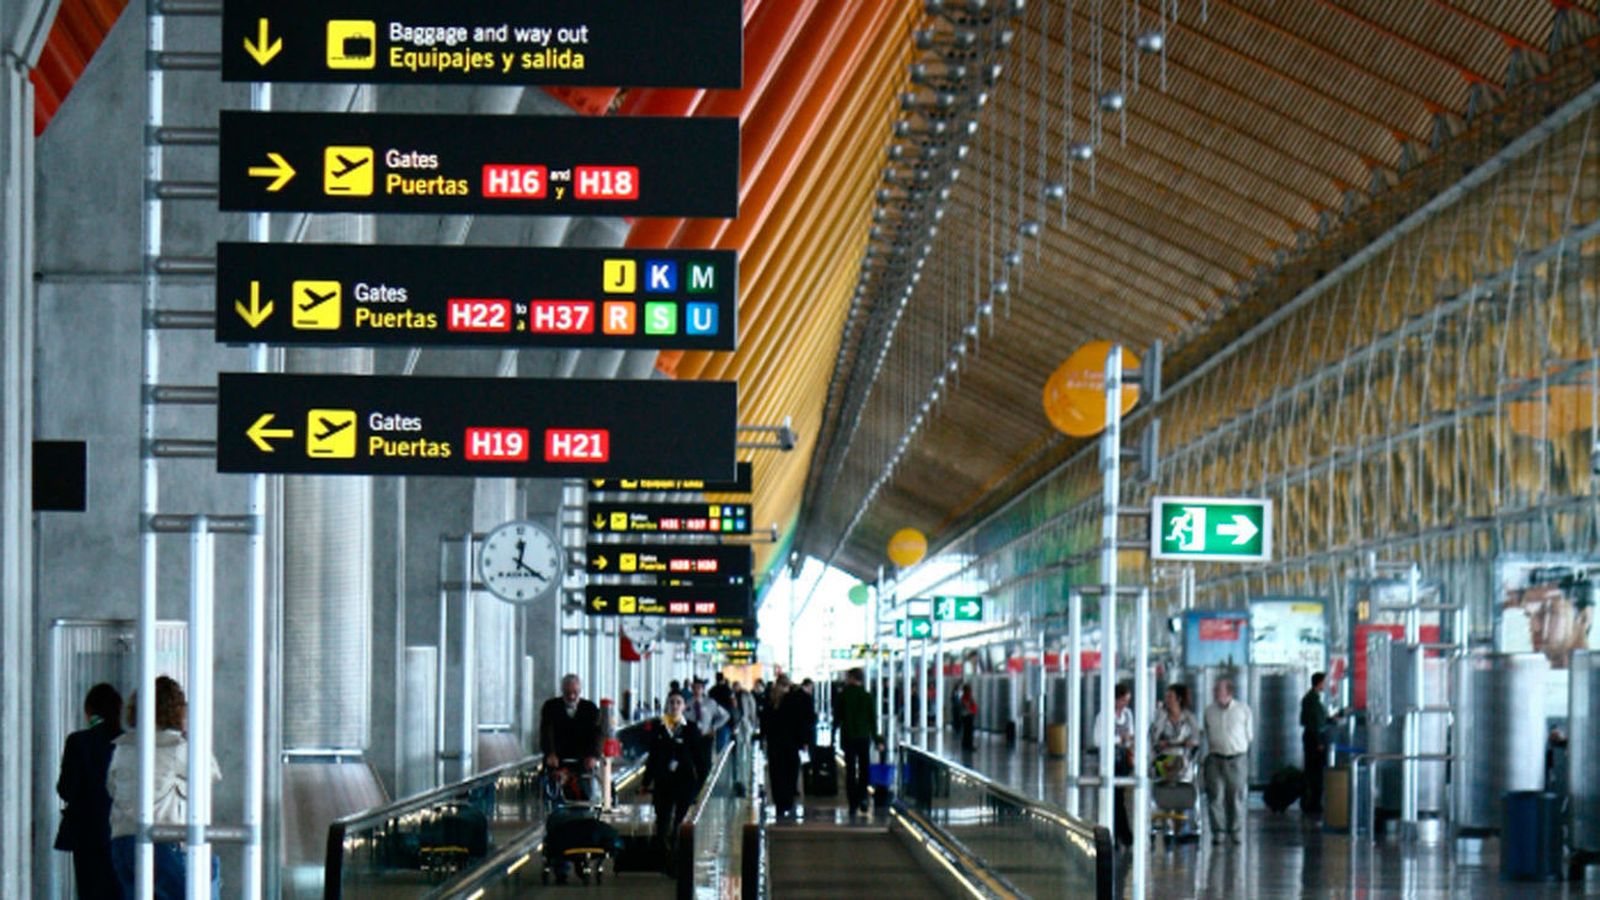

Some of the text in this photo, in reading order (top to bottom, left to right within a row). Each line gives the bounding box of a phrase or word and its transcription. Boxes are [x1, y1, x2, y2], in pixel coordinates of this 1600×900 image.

[389, 22, 589, 48] Baggage and way out
[389, 47, 585, 73] Equipajes y salida
[385, 149, 438, 169] Gates
[386, 169, 540, 196] Puertas H16
[549, 168, 571, 181] and
[580, 170, 633, 196] H18
[555, 187, 565, 200] y
[651, 264, 671, 289] K
[692, 265, 714, 289] M
[353, 283, 408, 303] Gates
[355, 303, 506, 329] Puertas H22
[515, 303, 527, 315] to
[535, 305, 590, 330] H37
[609, 306, 712, 331] R S U
[368, 411, 422, 432] Gates
[369, 431, 603, 458] Puertas H19 H21
